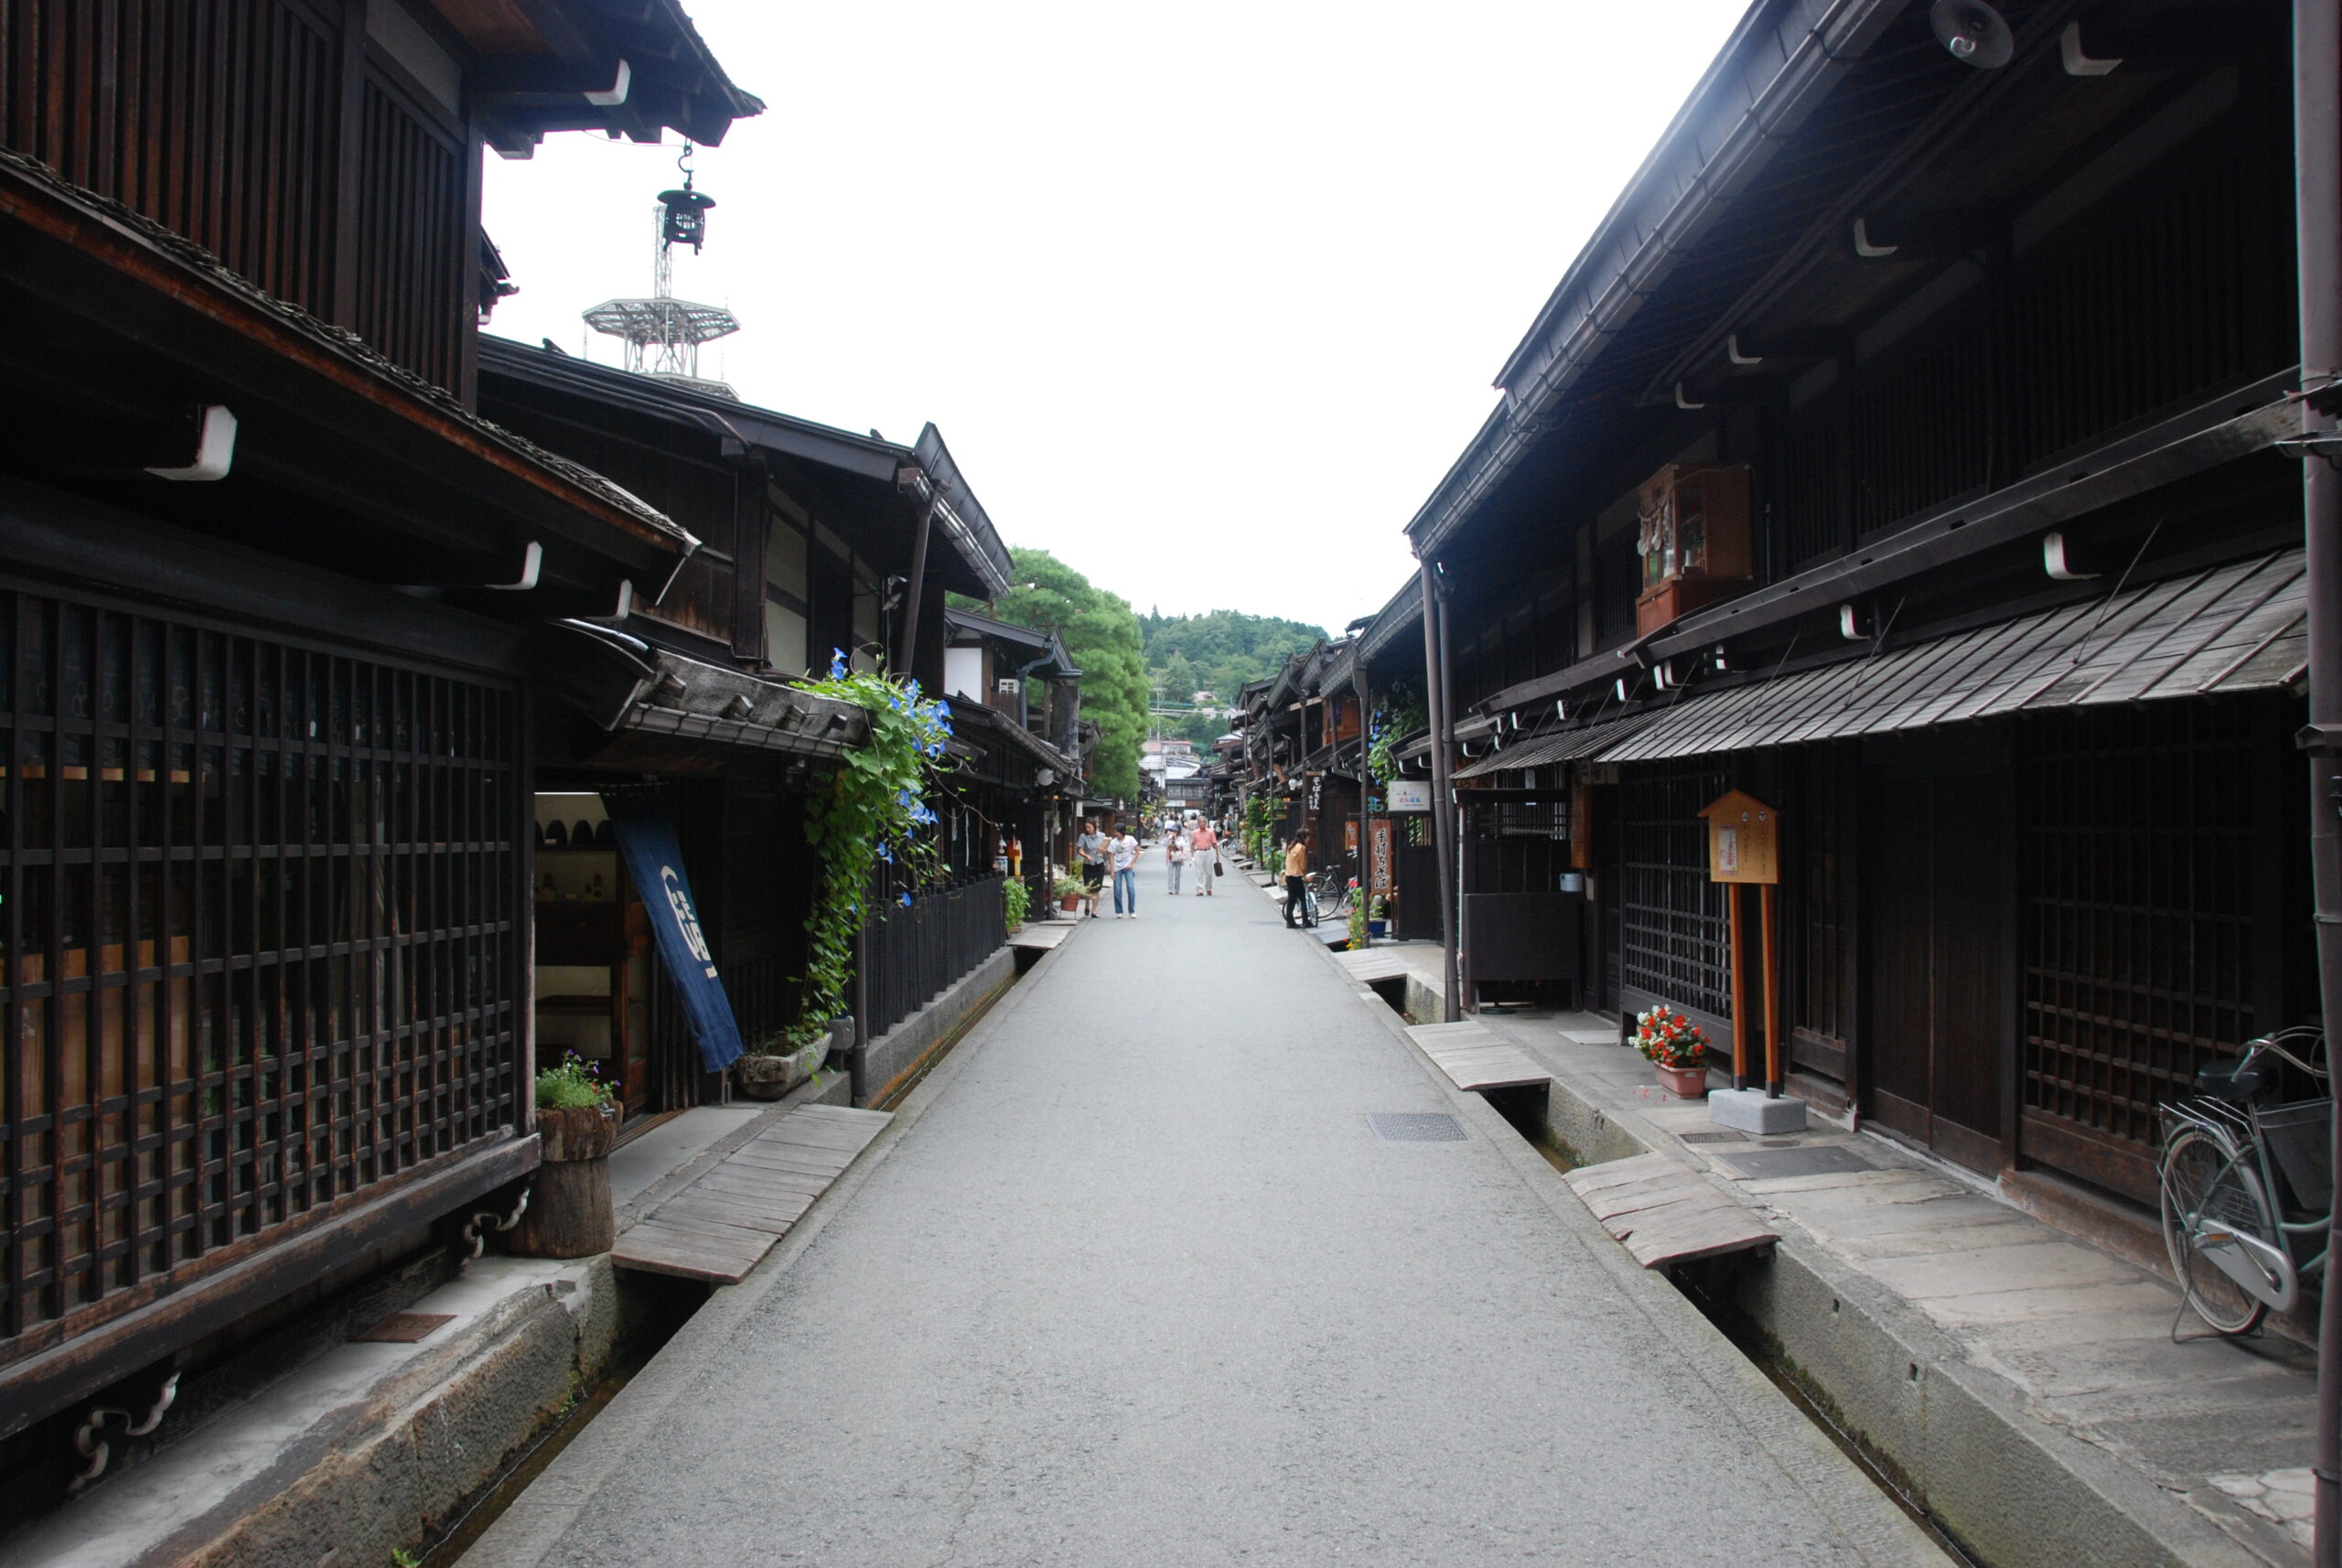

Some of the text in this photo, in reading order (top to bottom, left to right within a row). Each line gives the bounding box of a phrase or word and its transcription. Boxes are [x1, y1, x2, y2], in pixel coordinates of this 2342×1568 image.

[1375, 828, 1389, 889] 手打ちそば
